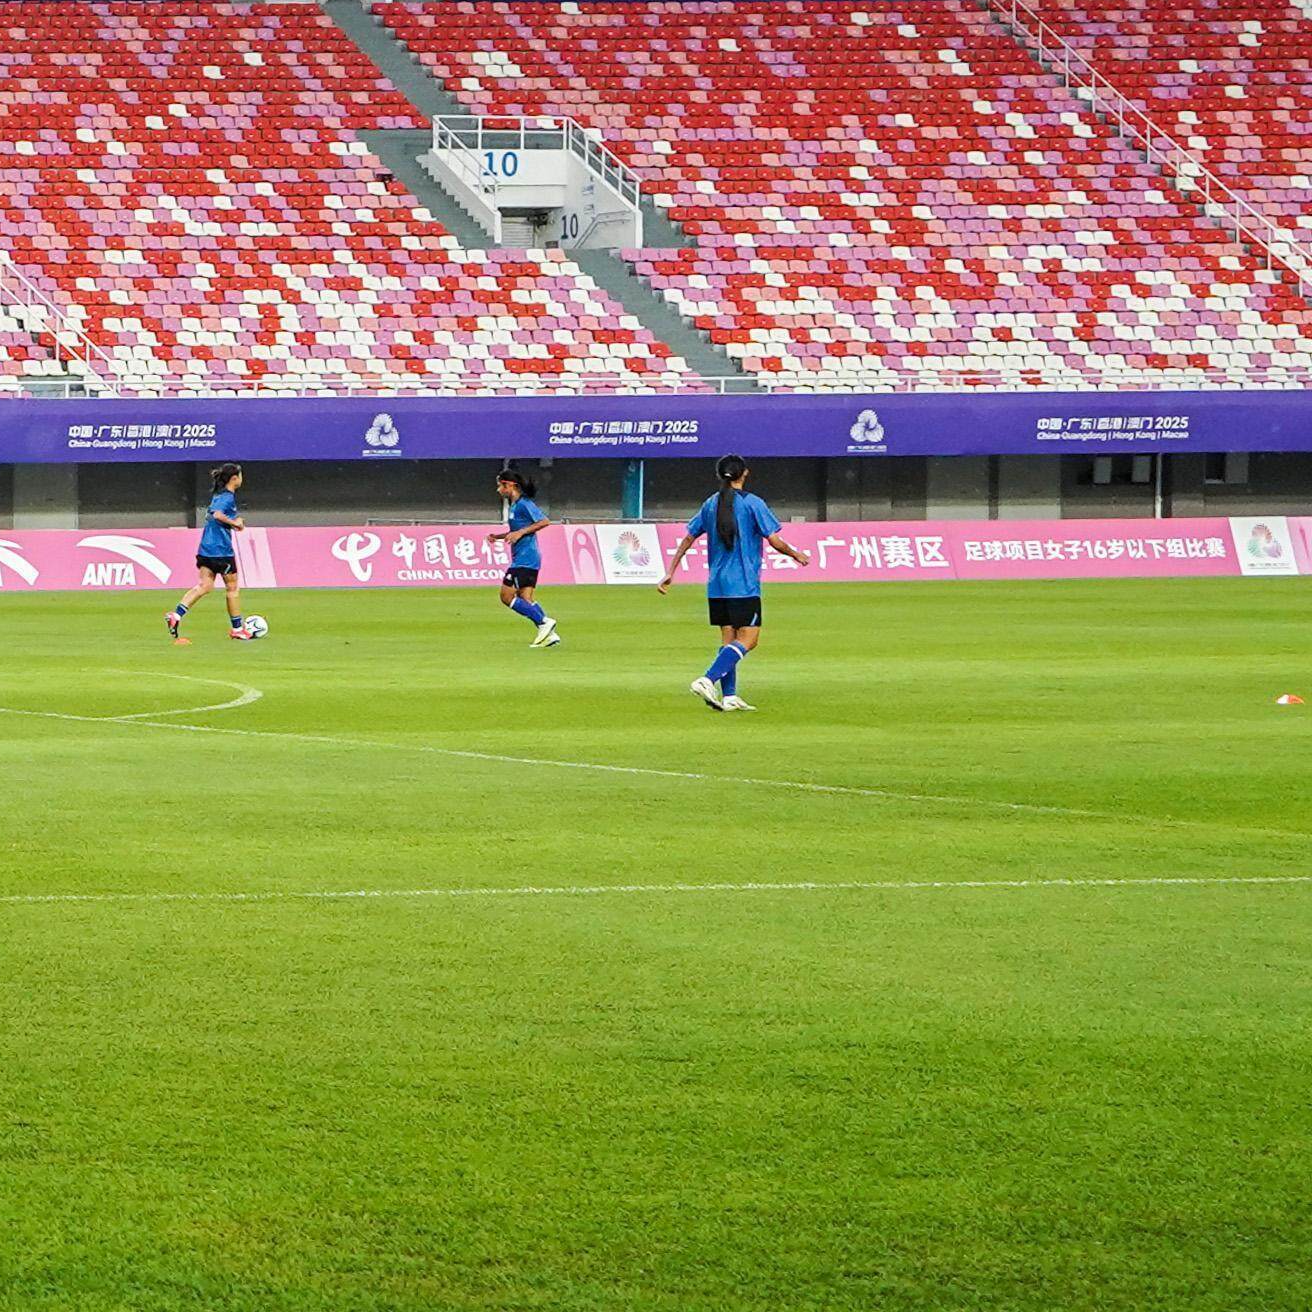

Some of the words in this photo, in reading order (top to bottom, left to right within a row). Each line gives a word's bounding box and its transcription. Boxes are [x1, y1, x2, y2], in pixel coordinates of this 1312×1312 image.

[482, 151, 519, 178] 10
[560, 214, 579, 241] 10
[665, 421, 699, 433] 2025
[1155, 418, 1189, 429] 2025
[182, 425, 216, 437] 2025
[141, 440, 163, 449] Hong
[164, 440, 184, 448] Kong
[623, 436, 644, 444] Hong
[645, 436, 666, 444] Kong
[964, 538, 1227, 561] 足球项目女子16岁以下组比赛
[81, 562, 136, 586] ANTA
[397, 569, 443, 581] CHINA
